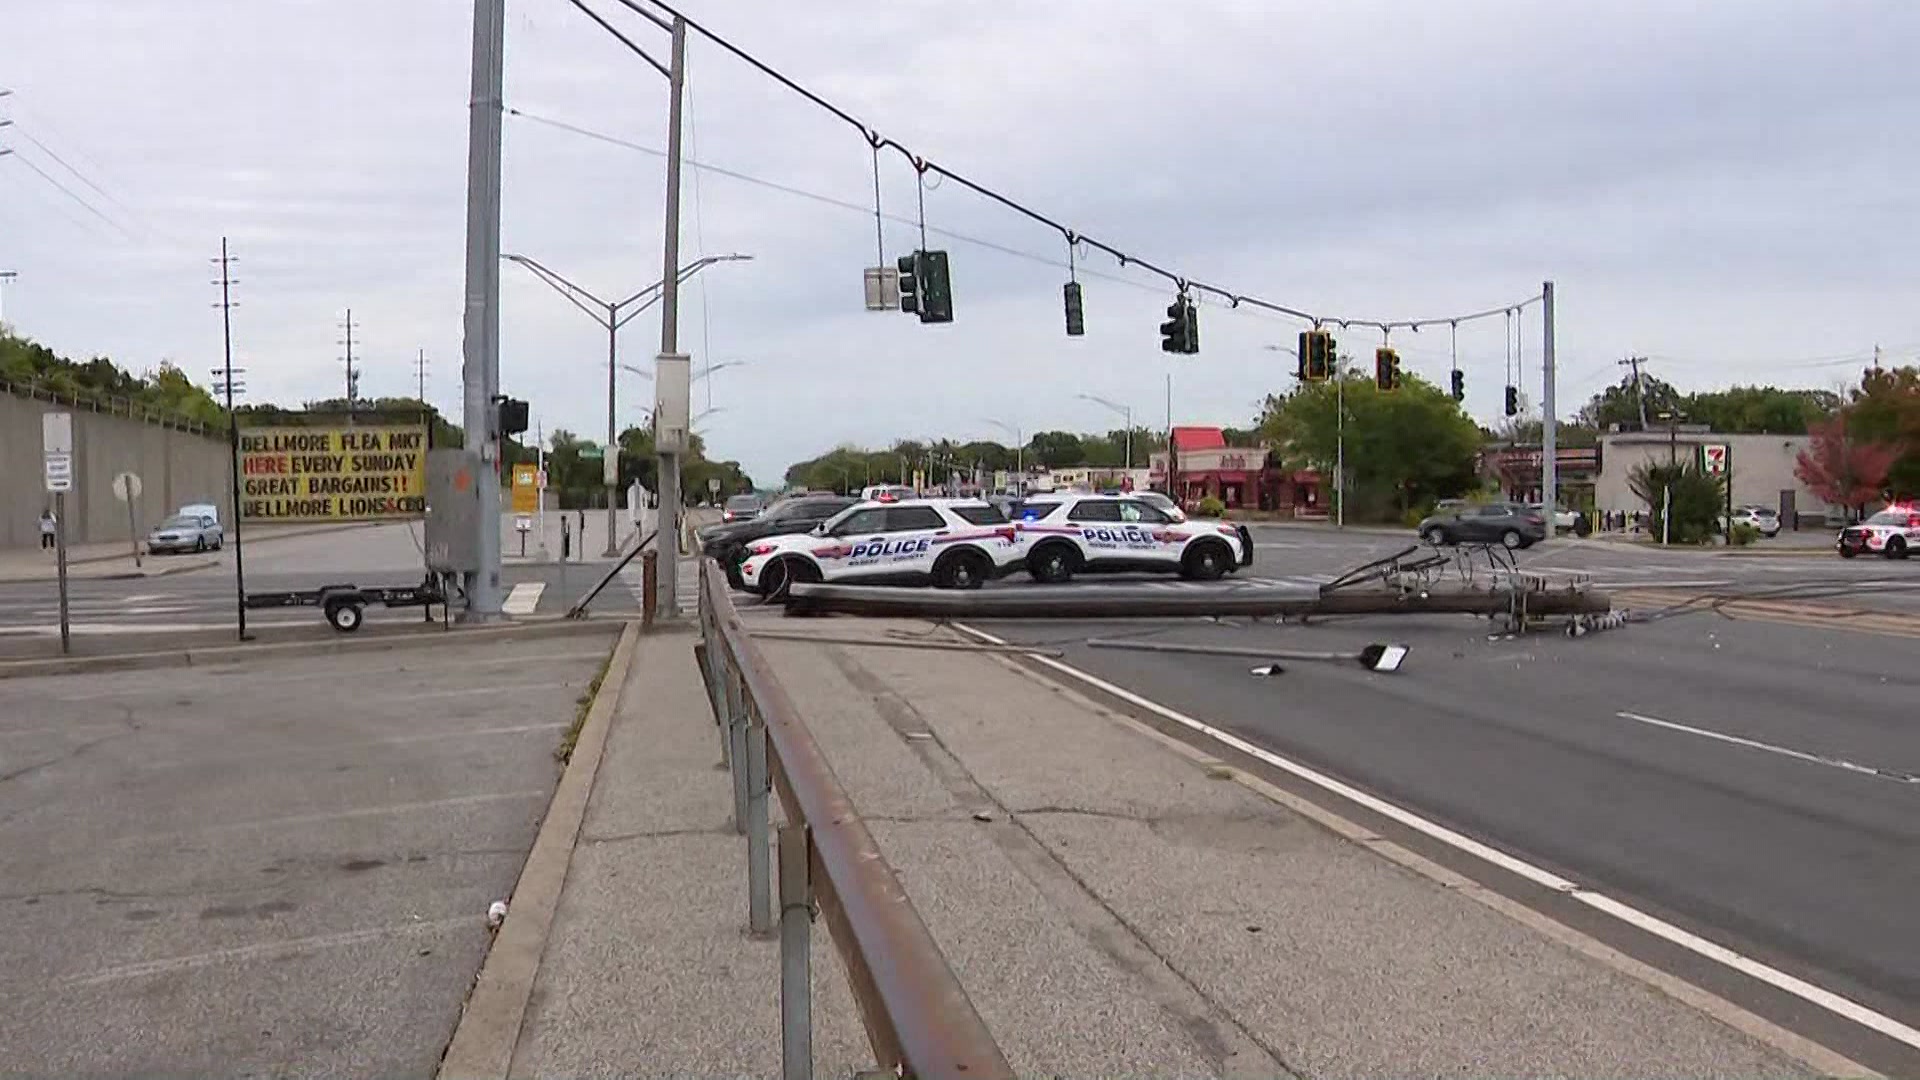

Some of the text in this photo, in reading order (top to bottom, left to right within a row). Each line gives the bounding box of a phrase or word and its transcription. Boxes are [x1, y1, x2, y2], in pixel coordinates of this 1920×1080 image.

[241, 433, 422, 452] BELLMORE FLEA MKT
[243, 454, 416, 474] HERE EVERY SUNDAY
[246, 476, 408, 496] GREAT BARGAINS!!
[243, 499, 332, 518] BELLMORE
[1083, 529, 1153, 544] POLICE
[852, 540, 931, 559] POLICE
